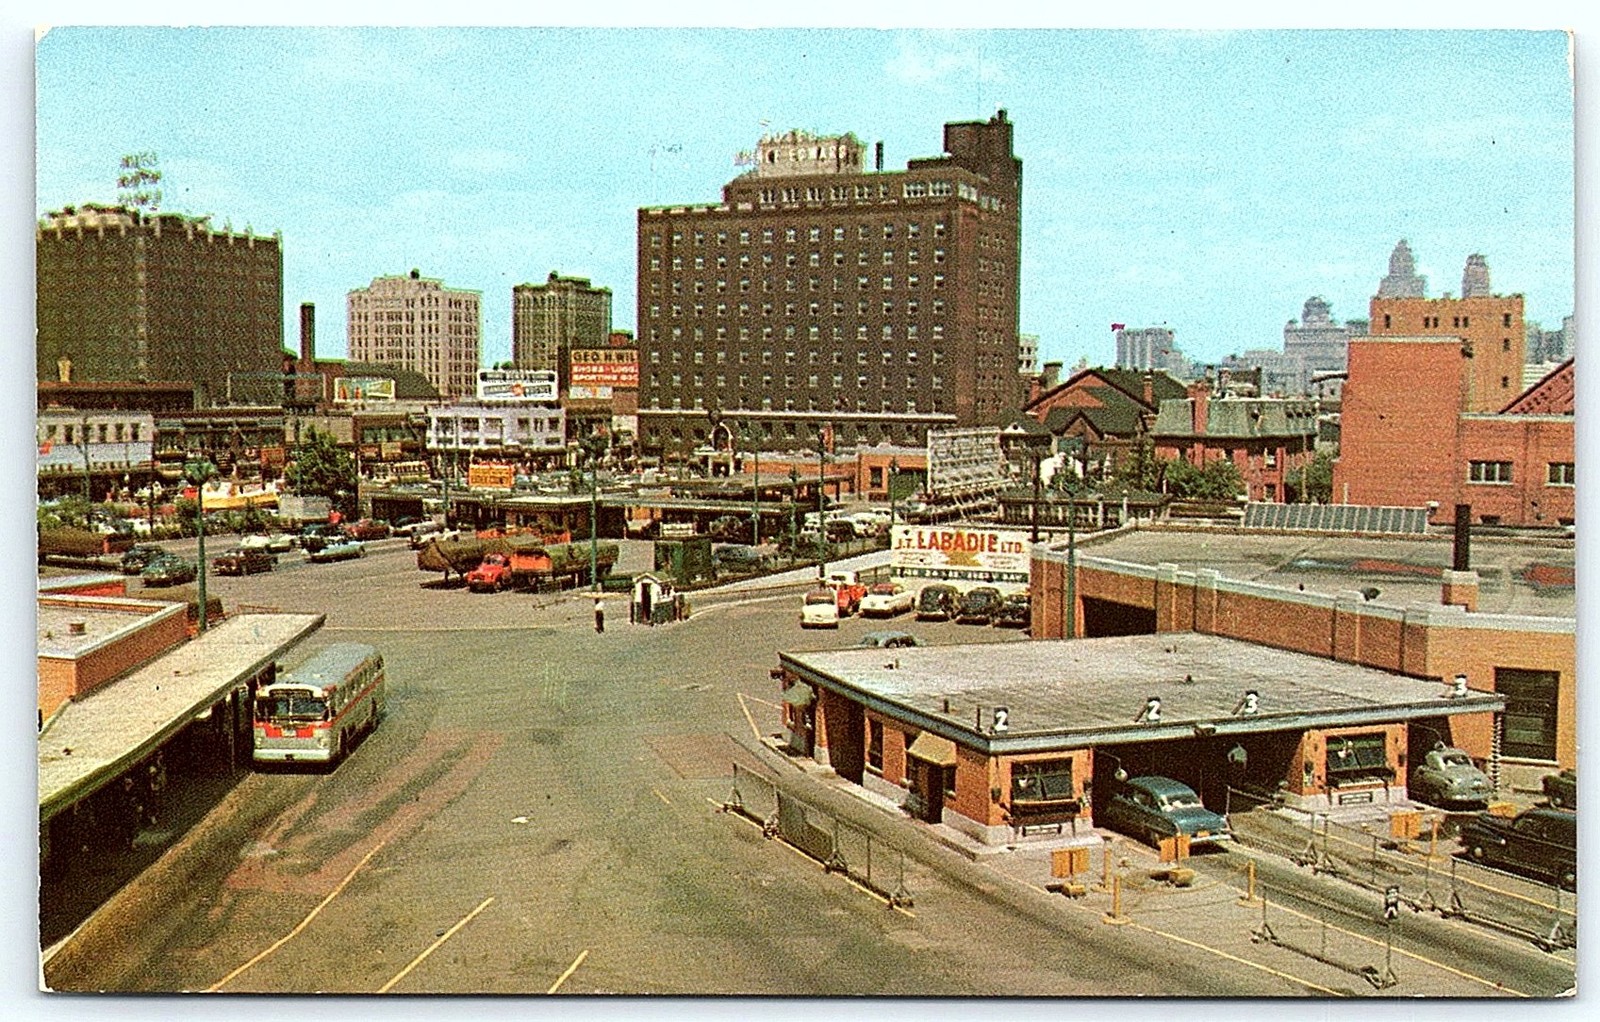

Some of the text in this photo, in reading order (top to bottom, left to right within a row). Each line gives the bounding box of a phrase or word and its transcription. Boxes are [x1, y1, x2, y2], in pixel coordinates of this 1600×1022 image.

[894, 530, 1025, 554] J.T. LABADIE LTD.
[1455, 677, 1467, 695] 3
[1147, 700, 1161, 720] 2
[1245, 693, 1258, 714] 3
[995, 710, 1008, 731] 2
